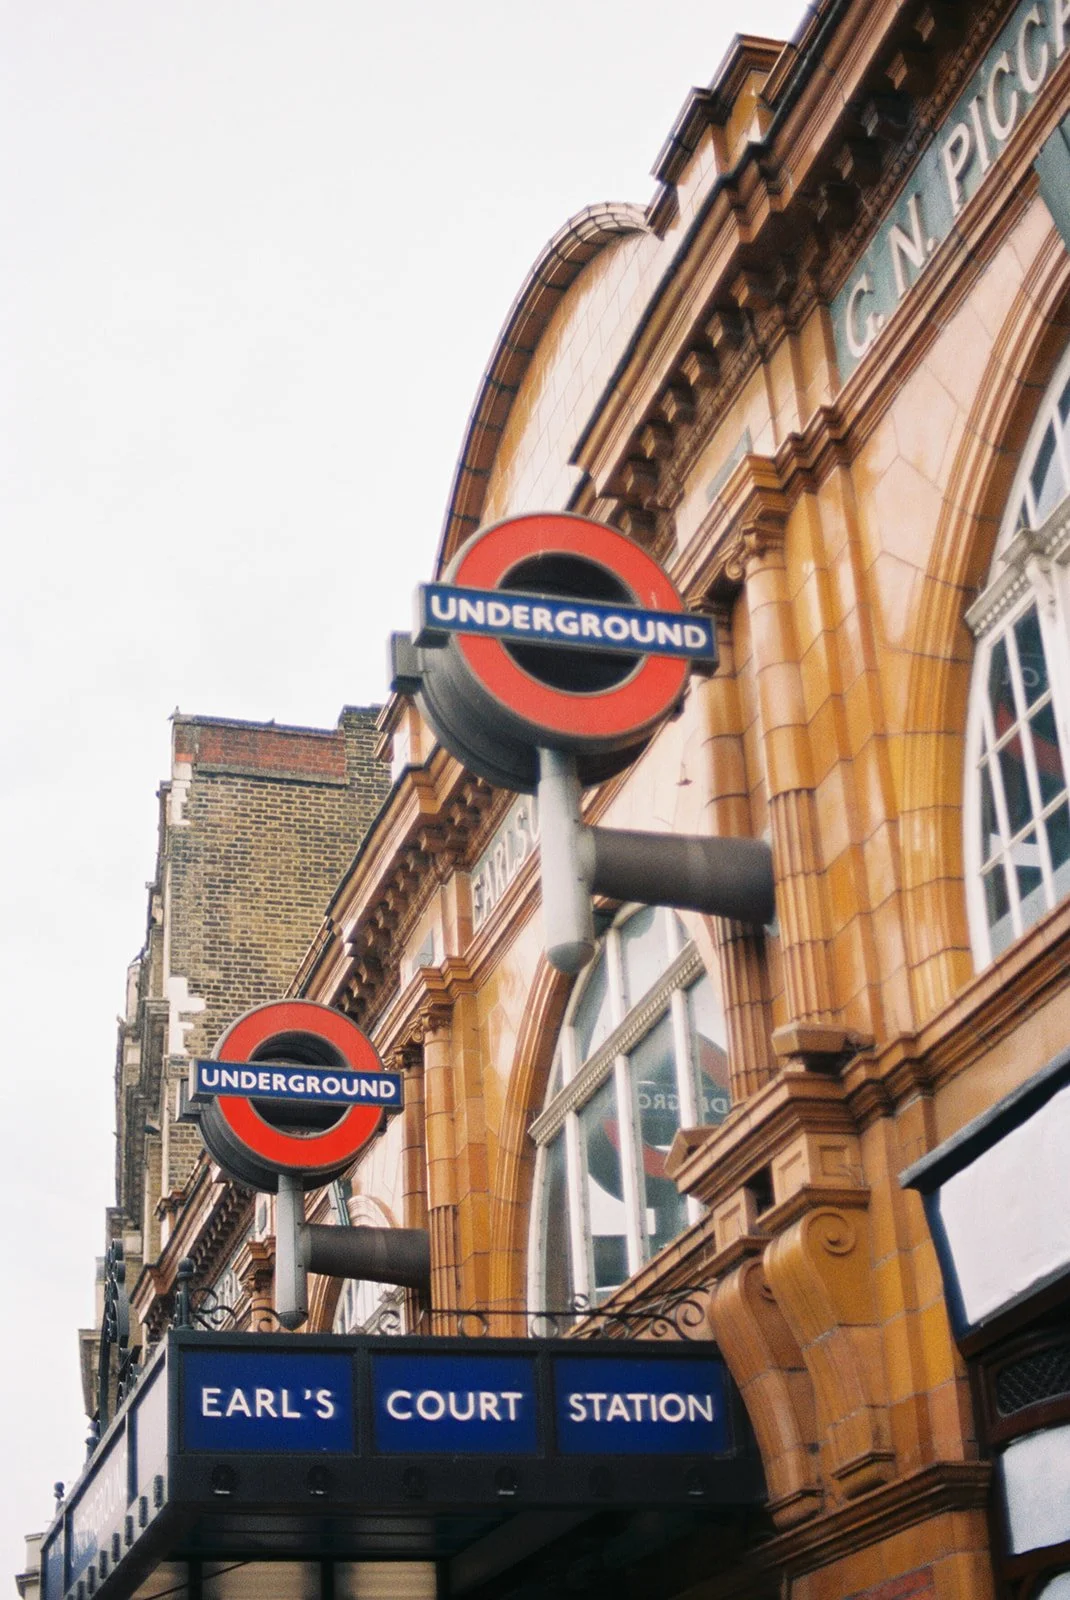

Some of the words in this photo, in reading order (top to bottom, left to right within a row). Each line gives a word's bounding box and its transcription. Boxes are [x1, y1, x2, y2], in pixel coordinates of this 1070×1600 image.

[431, 595, 707, 649] UNDERGROUND
[201, 1068, 396, 1098] UNDERGROUND
[202, 1388, 335, 1420] EARL'S
[387, 1390, 523, 1422] COURT
[569, 1392, 713, 1423] STATION
